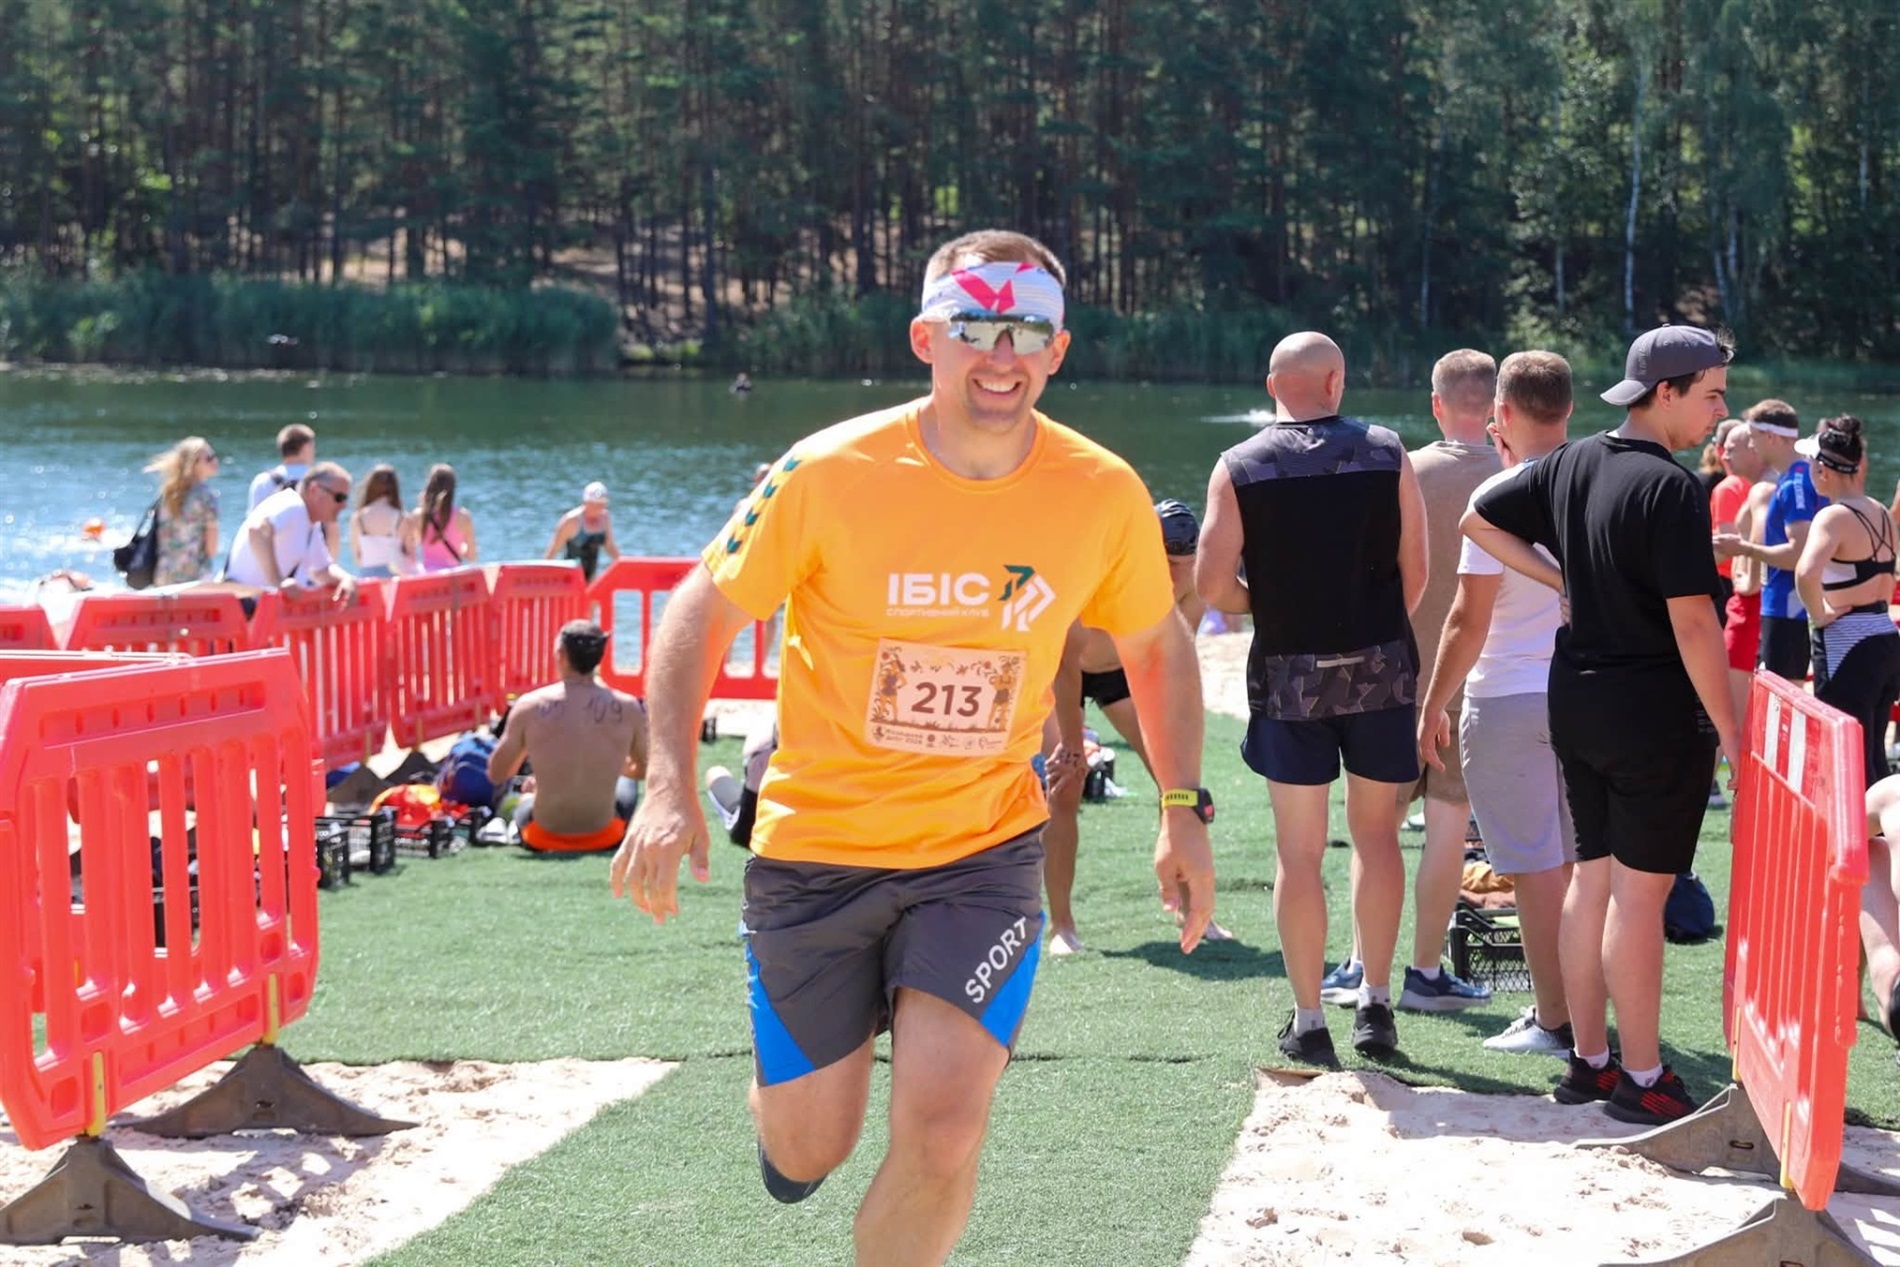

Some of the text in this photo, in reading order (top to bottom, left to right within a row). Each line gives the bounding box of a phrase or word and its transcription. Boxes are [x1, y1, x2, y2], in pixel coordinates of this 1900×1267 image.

[887, 572, 991, 606] ІБІС
[911, 681, 982, 718] 213
[965, 916, 1026, 1004] SPORT
